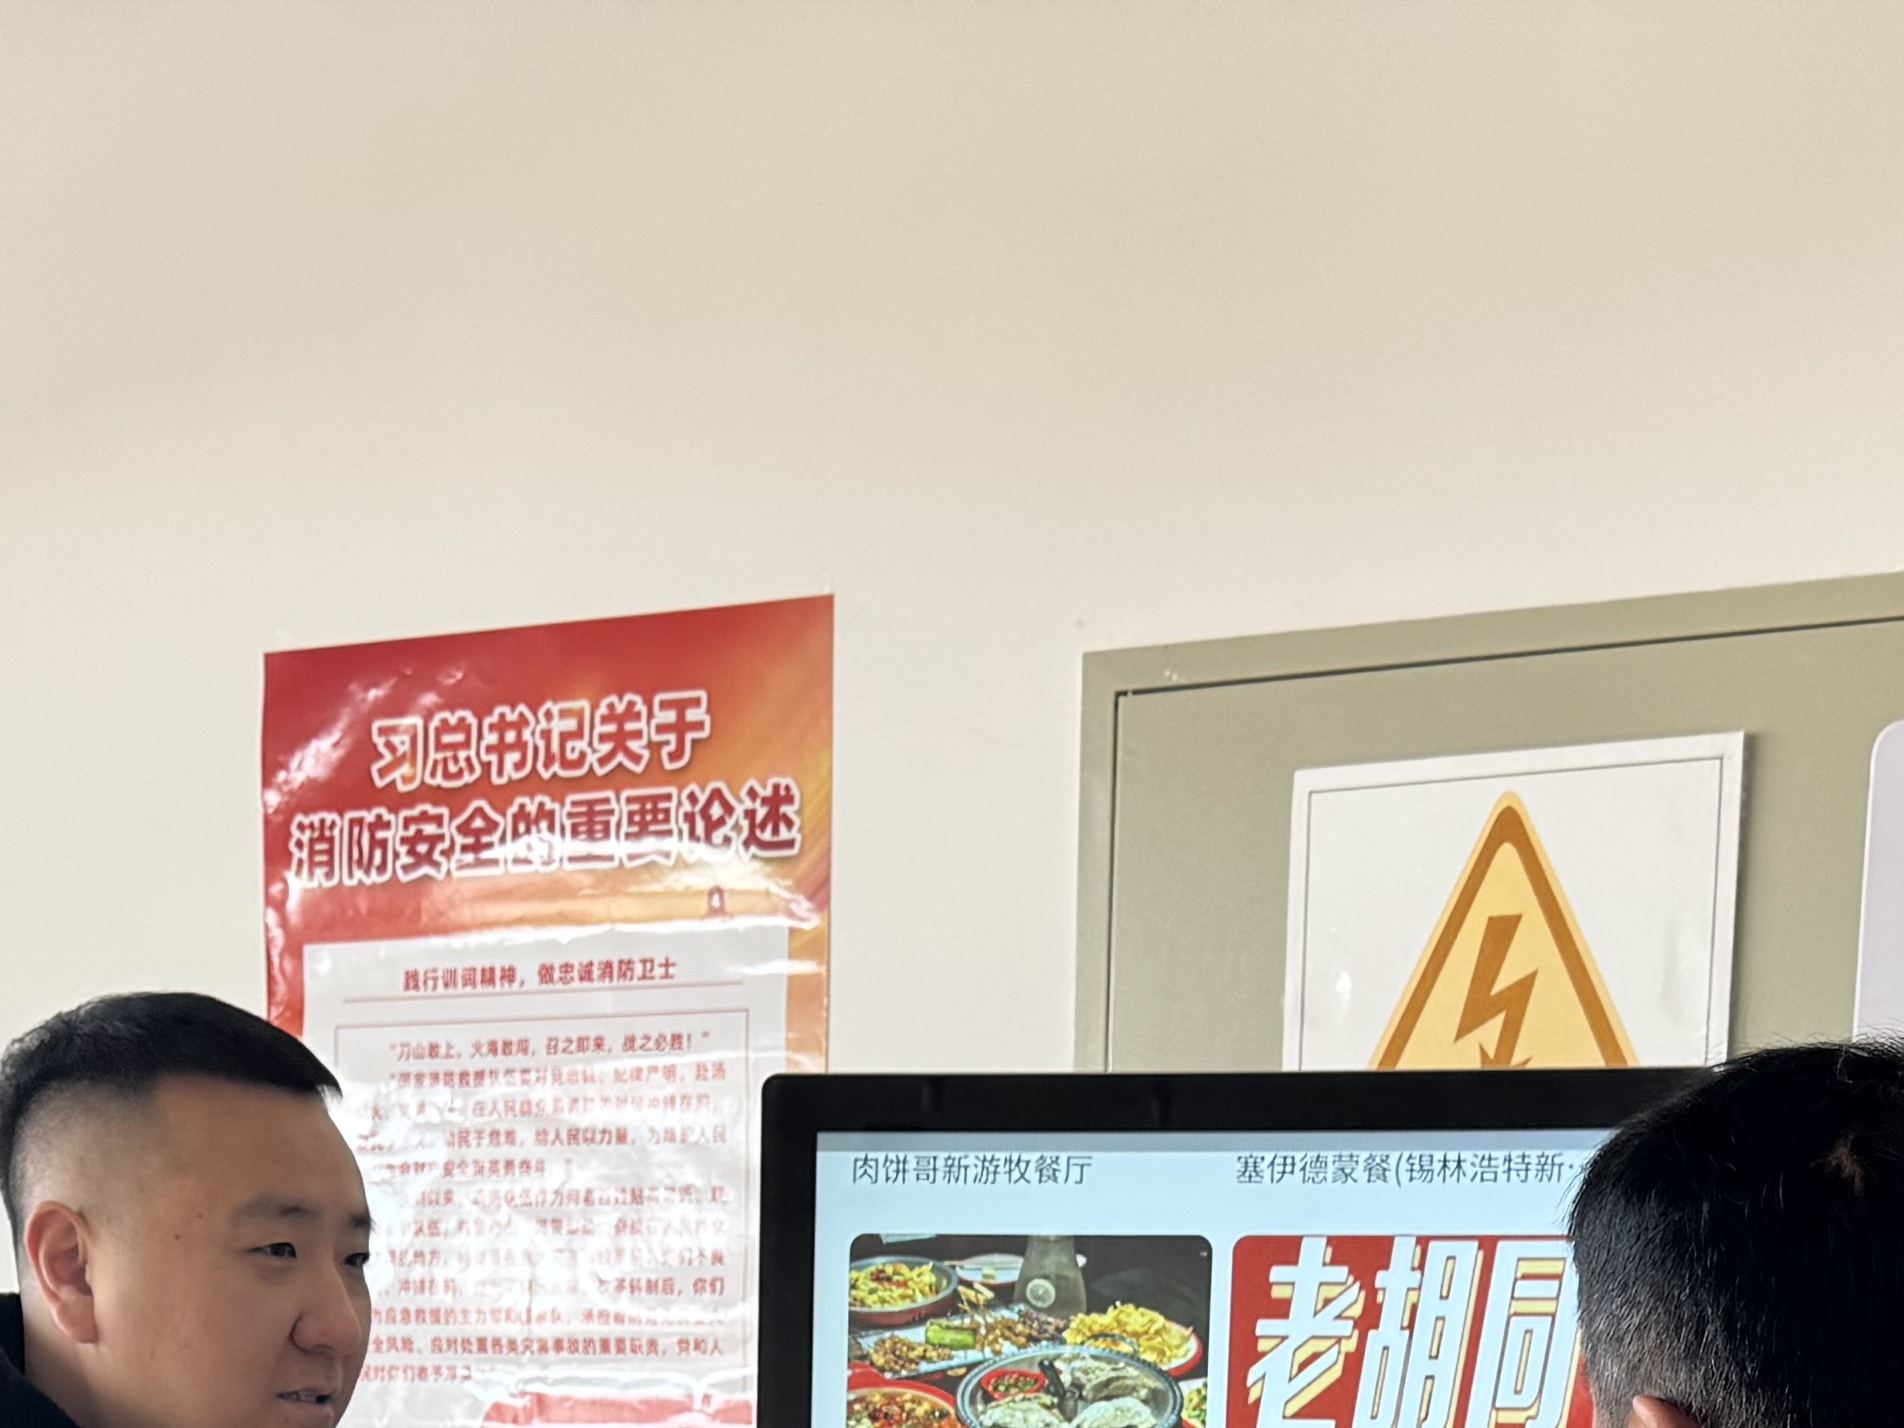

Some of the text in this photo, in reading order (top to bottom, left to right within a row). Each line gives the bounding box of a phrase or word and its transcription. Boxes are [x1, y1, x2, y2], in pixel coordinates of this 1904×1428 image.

[371, 690, 711, 792] 习总书记关于
[289, 777, 802, 887] 消防安全的重要论述
[851, 1151, 1093, 1188] 肉饼哥新游牧餐厅
